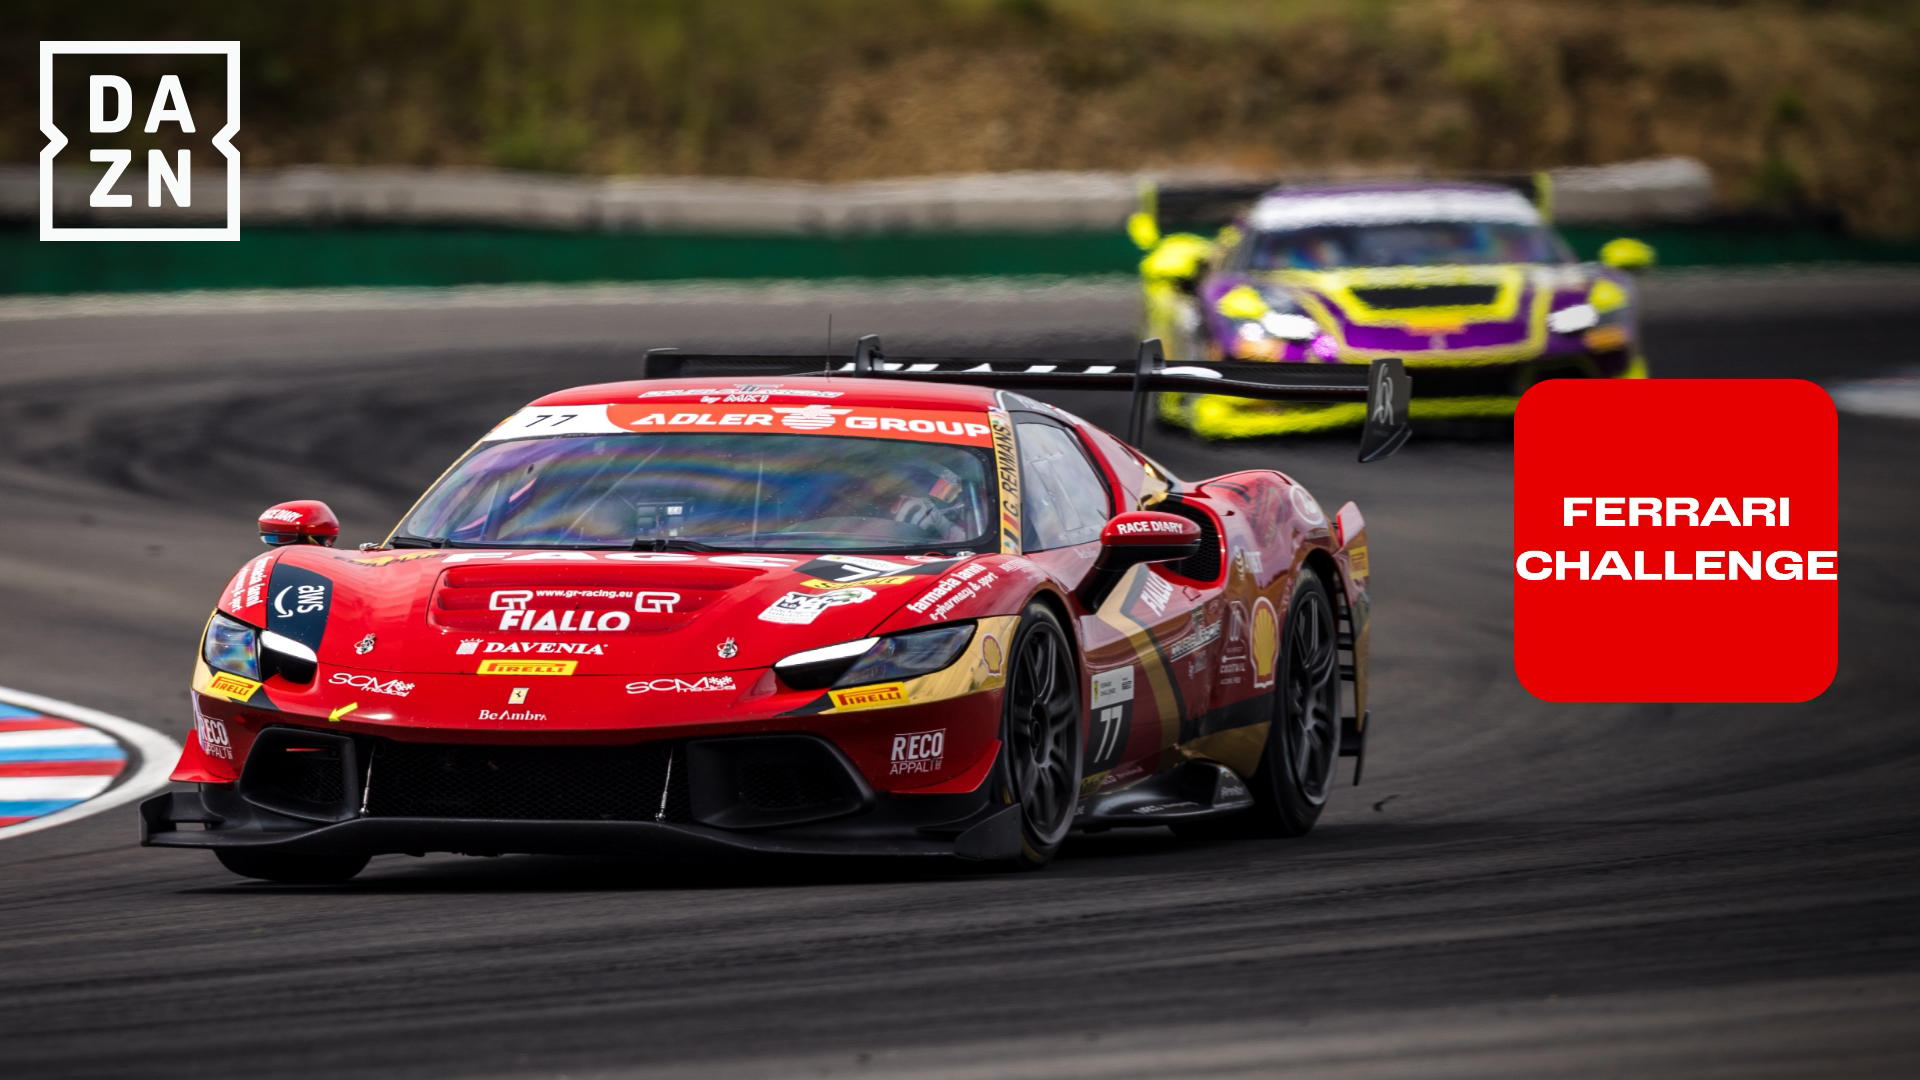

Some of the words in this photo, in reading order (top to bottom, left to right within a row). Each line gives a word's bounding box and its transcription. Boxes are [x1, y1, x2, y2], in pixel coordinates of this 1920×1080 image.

[525, 414, 578, 428] 77
[630, 413, 773, 426] ADLER
[845, 416, 991, 437] GROUP
[993, 423, 1018, 497] RENMANS
[1117, 521, 1150, 534] RACE
[1150, 520, 1183, 534] DIARY
[297, 585, 325, 614] aws
[536, 589, 633, 599] www.gr-racing.eu
[906, 577, 962, 613] farmacia
[498, 610, 631, 631] FIALLO
[483, 641, 605, 655] DAVENIA
[487, 663, 567, 673] PIRELLI
[211, 676, 254, 696] PIRELLI
[625, 676, 710, 694] SCM
[838, 686, 902, 706] PIRELLI
[1094, 704, 1123, 763] 77
[890, 731, 943, 760] RECO
